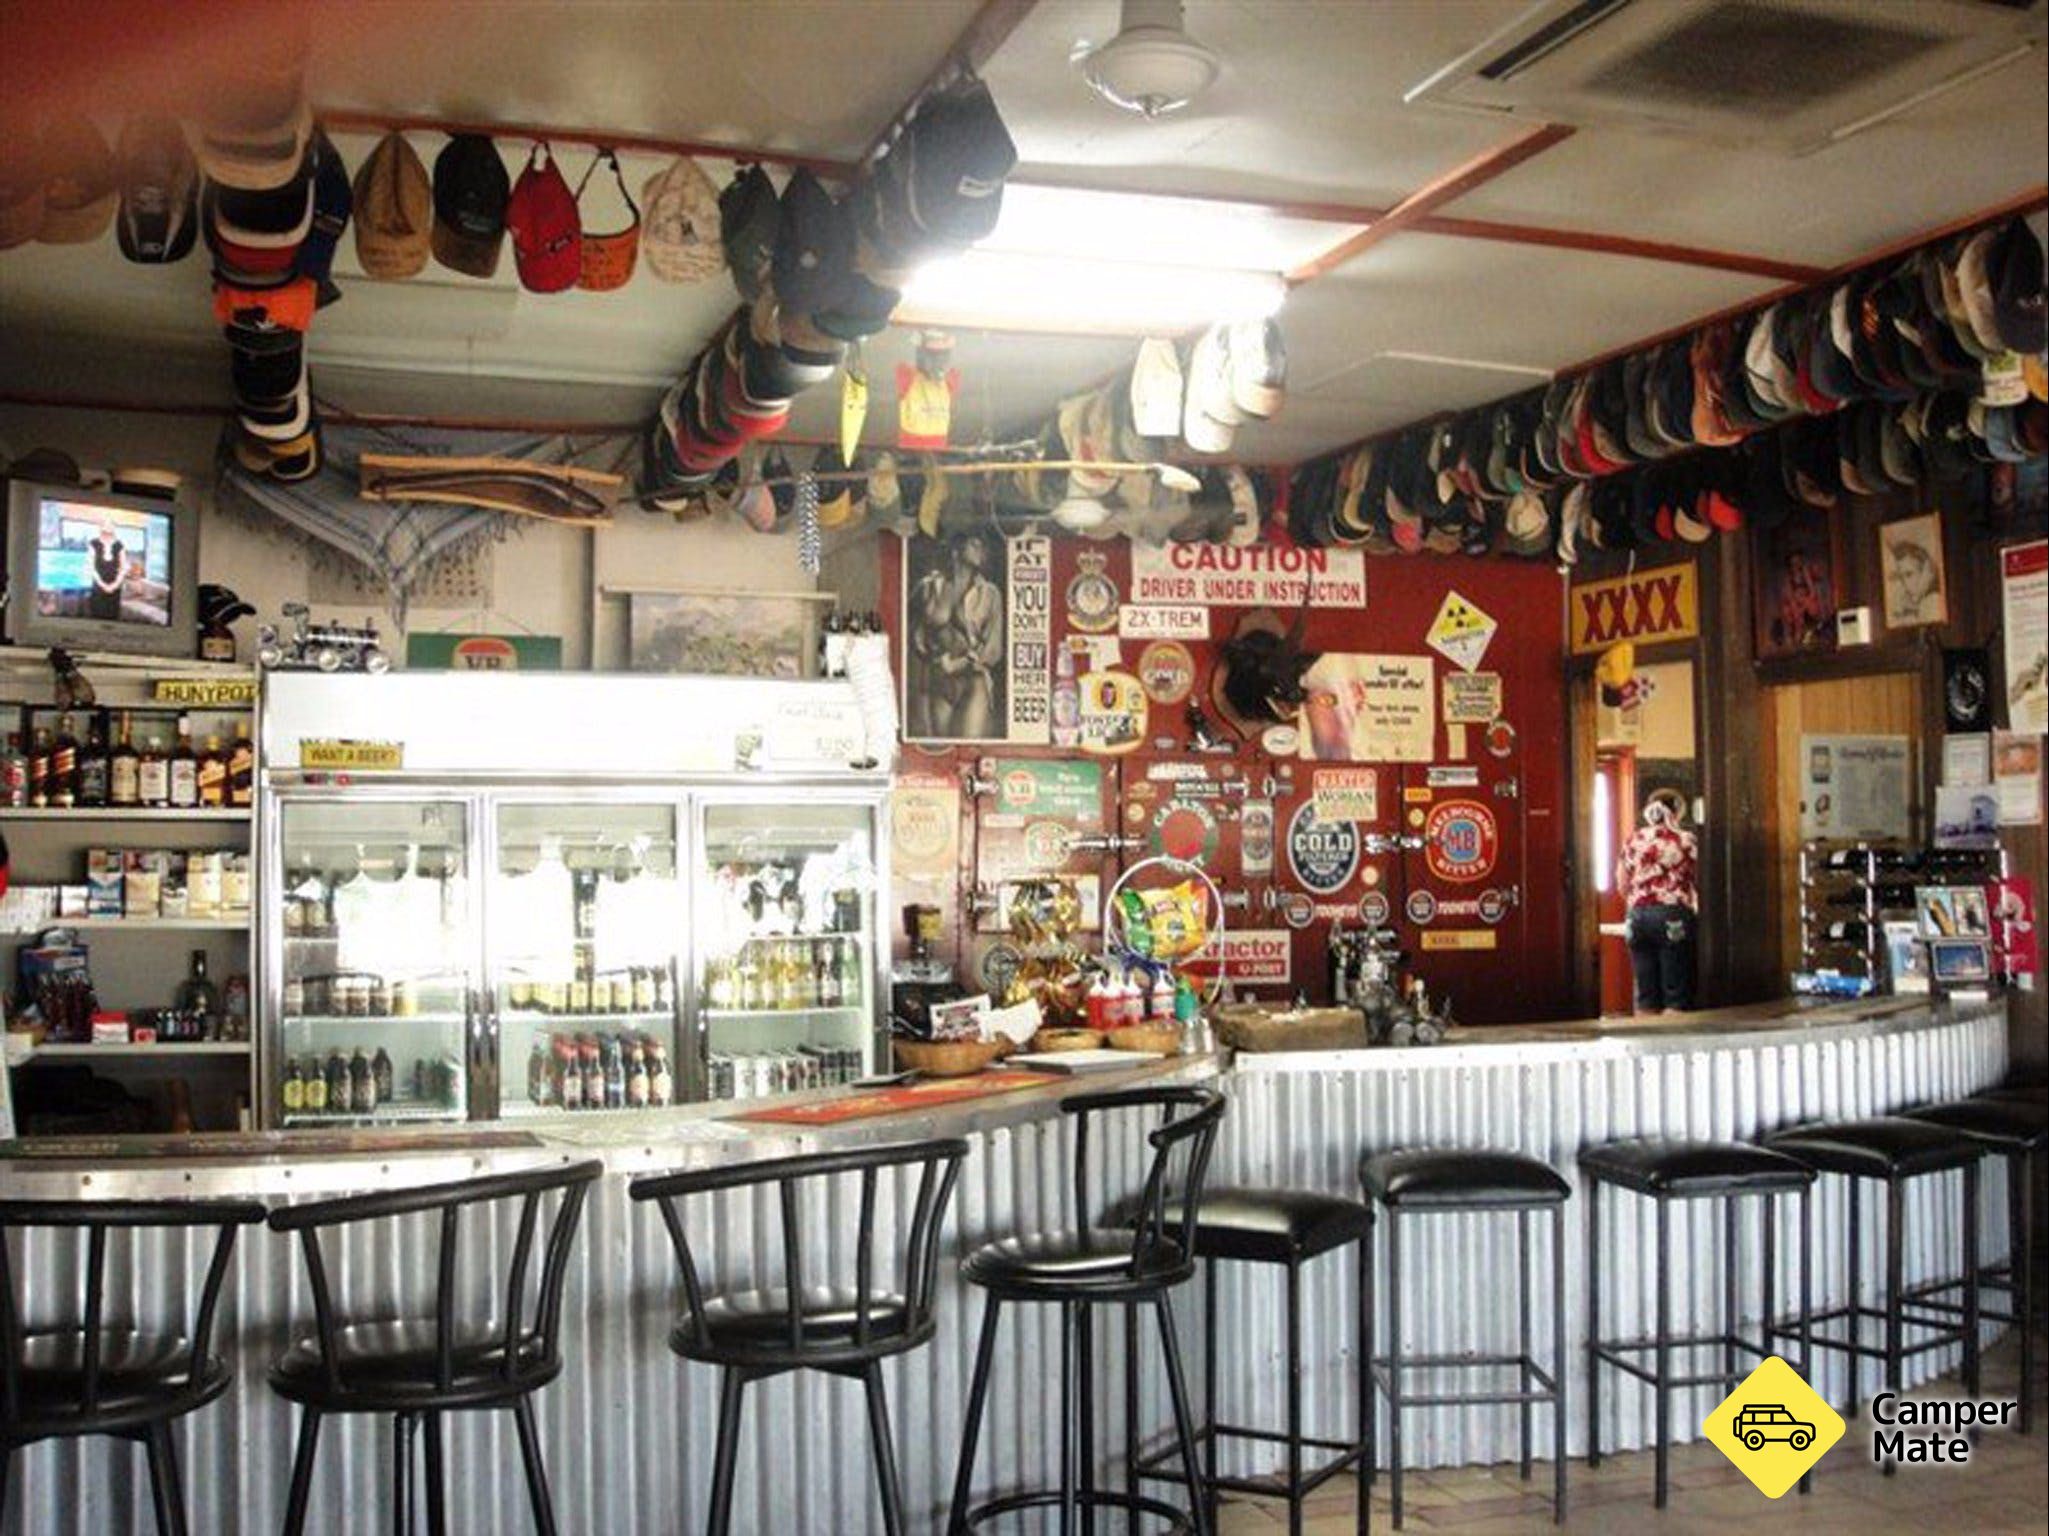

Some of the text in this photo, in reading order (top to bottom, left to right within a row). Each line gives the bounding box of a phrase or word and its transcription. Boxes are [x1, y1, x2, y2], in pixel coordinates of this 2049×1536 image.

[1015, 553, 1045, 565] AT
[1171, 542, 1327, 573] CAUTION
[1014, 585, 1046, 611] YOU
[1140, 577, 1360, 602] DRIVER UNDER INSTRUCTION
[1581, 574, 1682, 644] XXXX
[1015, 645, 1046, 668] BUY
[1014, 672, 1046, 686] HER
[164, 685, 254, 704] HUNYPOT
[1014, 697, 1046, 722] BEER
[1294, 833, 1352, 853] COLD
